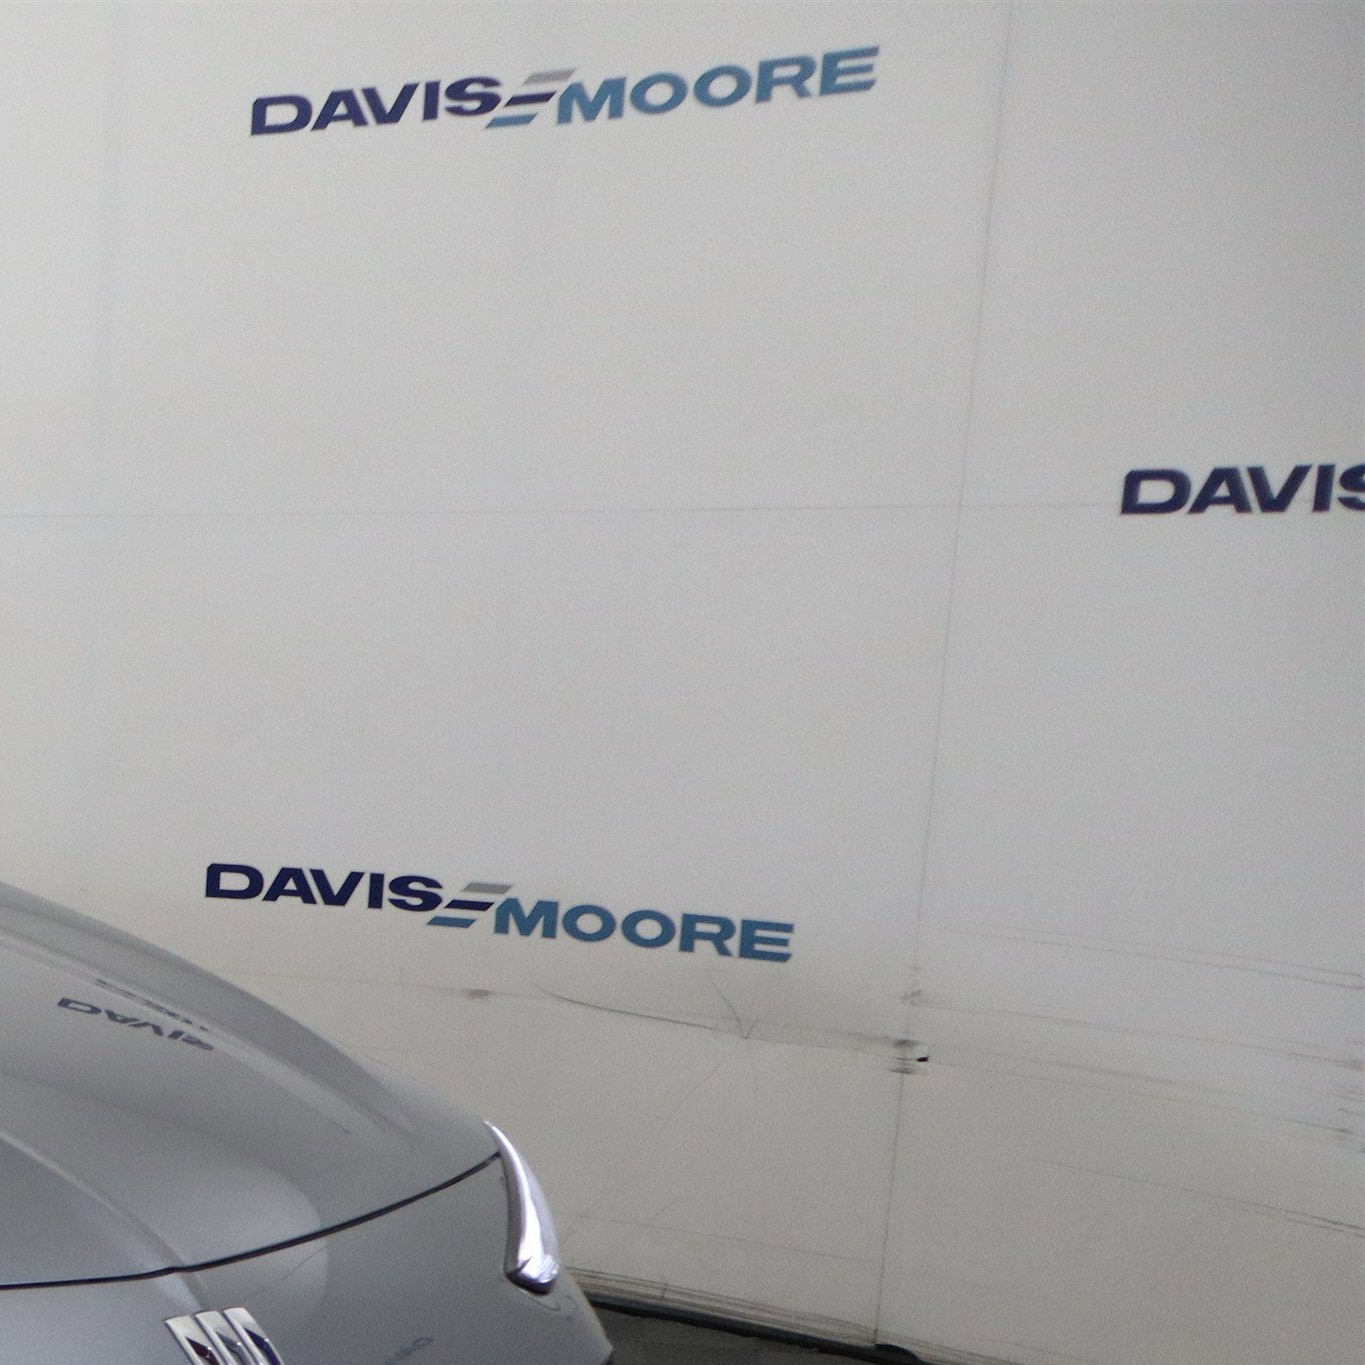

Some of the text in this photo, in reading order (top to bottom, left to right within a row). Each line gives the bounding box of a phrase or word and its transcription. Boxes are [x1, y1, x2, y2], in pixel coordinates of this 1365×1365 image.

[249, 46, 880, 137] DAVIS MOORE
[205, 863, 795, 963] DAVIS MOORE
